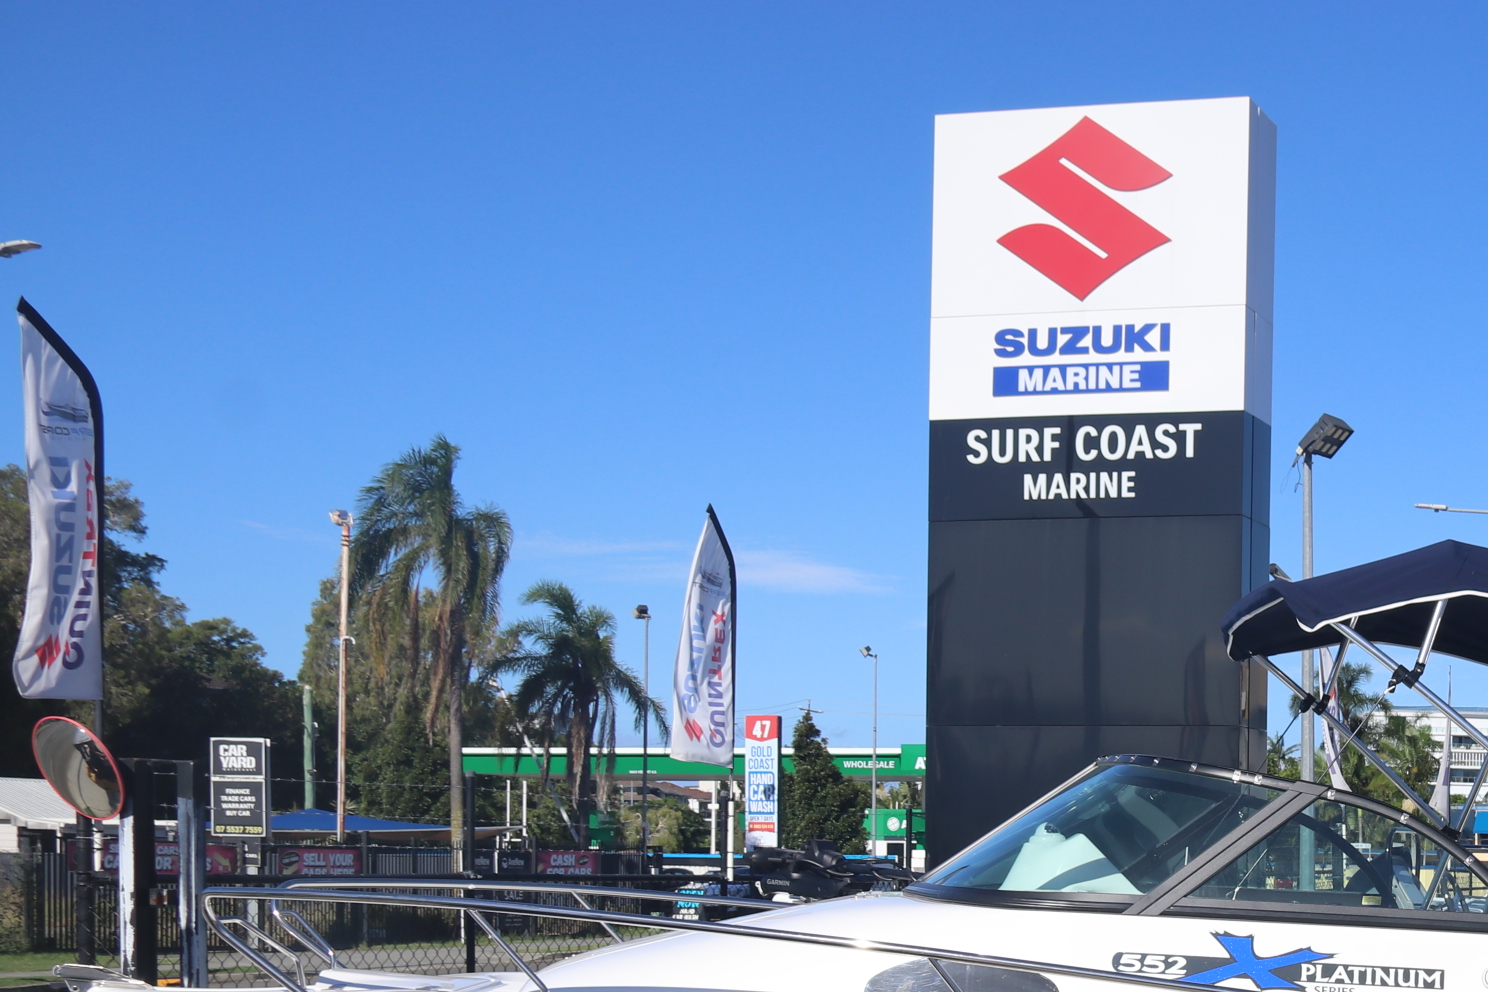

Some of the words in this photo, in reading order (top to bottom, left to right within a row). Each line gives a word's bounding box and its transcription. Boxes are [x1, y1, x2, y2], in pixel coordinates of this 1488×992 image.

[993, 322, 1171, 359] SUZUKI
[1018, 364, 1141, 392] MARINE
[966, 427, 1061, 465] SURF
[1075, 423, 1202, 461] COAST
[1023, 471, 1136, 500] MARINE
[752, 720, 771, 738] 47
[219, 744, 247, 757] CAR
[751, 746, 772, 757] GOLD
[219, 757, 256, 769] YARD
[748, 759, 775, 770] COAST
[843, 760, 895, 769] WHOLESALE
[750, 773, 774, 785] HAND
[750, 785, 775, 800] CAR
[750, 801, 774, 813] WASH
[303, 853, 326, 866] SELL
[329, 853, 354, 866] YOUR
[551, 855, 575, 866] CASH
[1116, 954, 1188, 975] 552
[1300, 962, 1443, 989] PLATINUM
